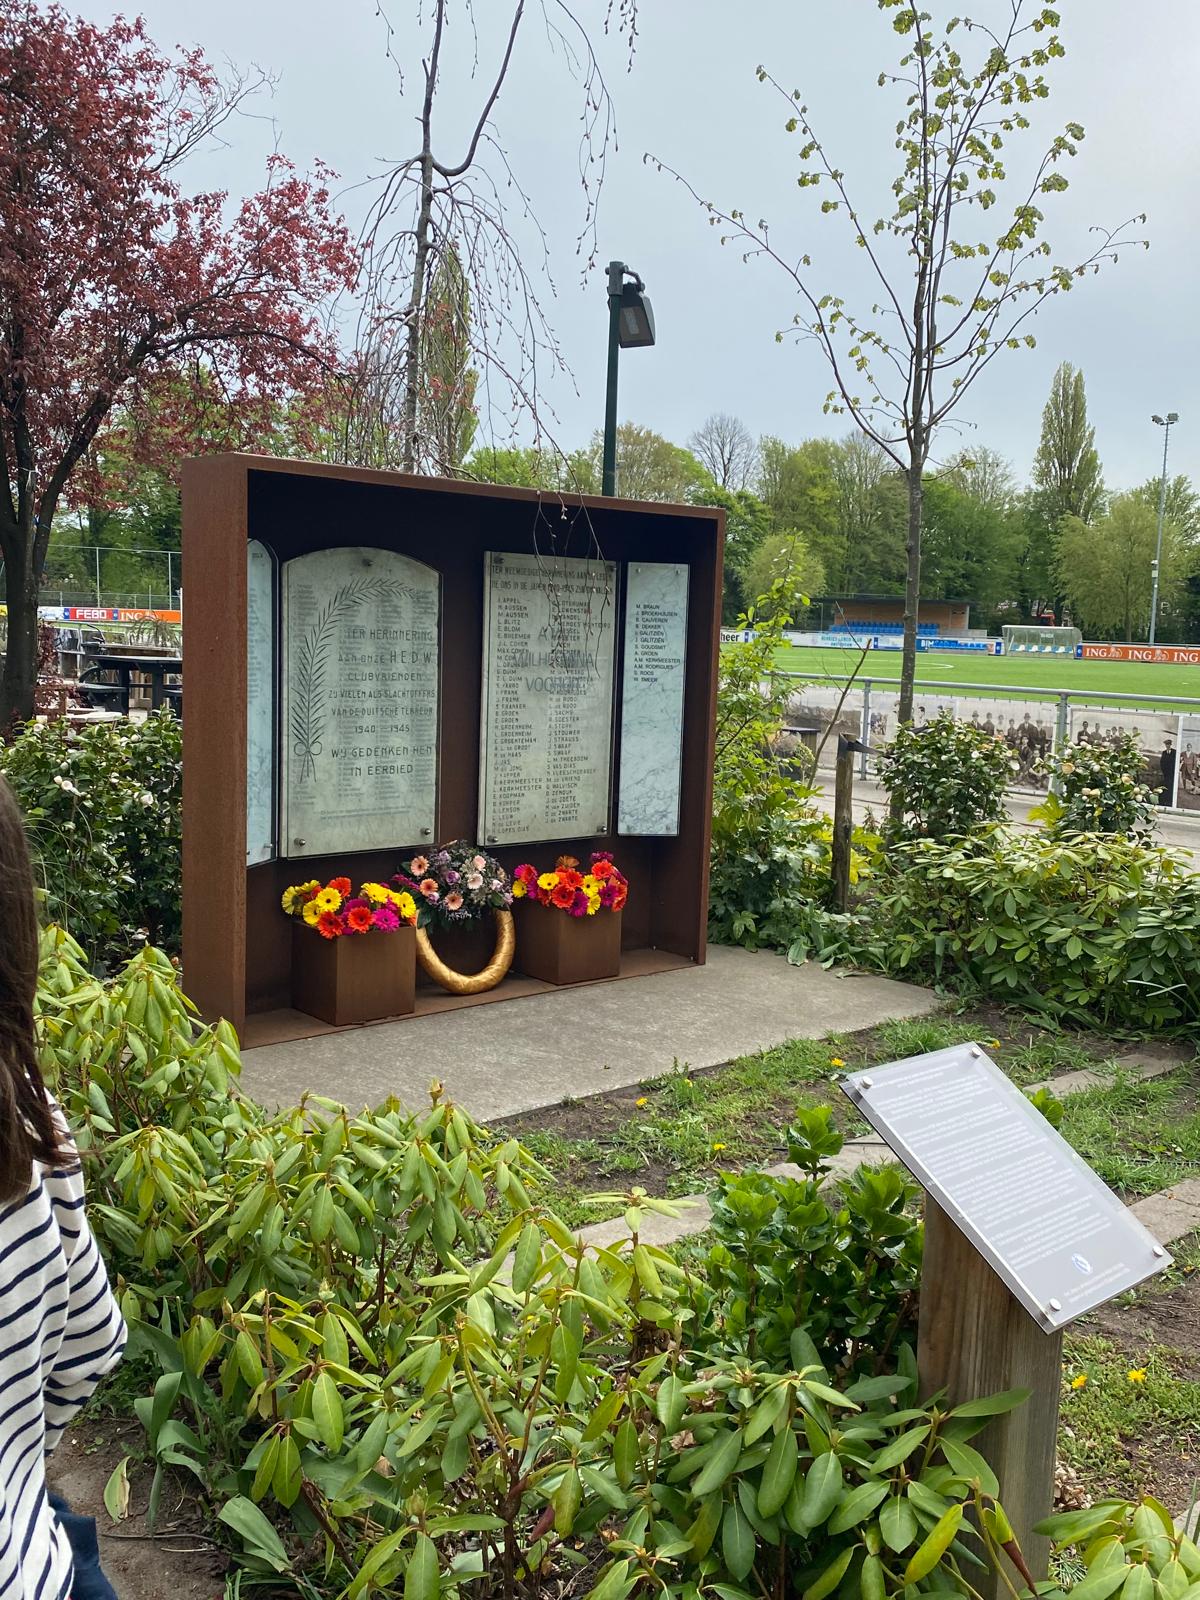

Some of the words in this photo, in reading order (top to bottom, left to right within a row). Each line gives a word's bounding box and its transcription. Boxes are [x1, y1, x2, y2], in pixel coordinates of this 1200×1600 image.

[76, 609, 107, 619] FEBO
[370, 629, 433, 641] HERINNERING
[1086, 647, 1107, 658] ING
[1128, 648, 1152, 661] ING
[1173, 651, 1200, 663] ING
[347, 672, 422, 682] CLUBVRIENDEN
[341, 689, 367, 699] VIELEN
[351, 746, 409, 758] GEDENKEN
[412, 746, 432, 756] HEN
[367, 764, 414, 776] EERBIED
